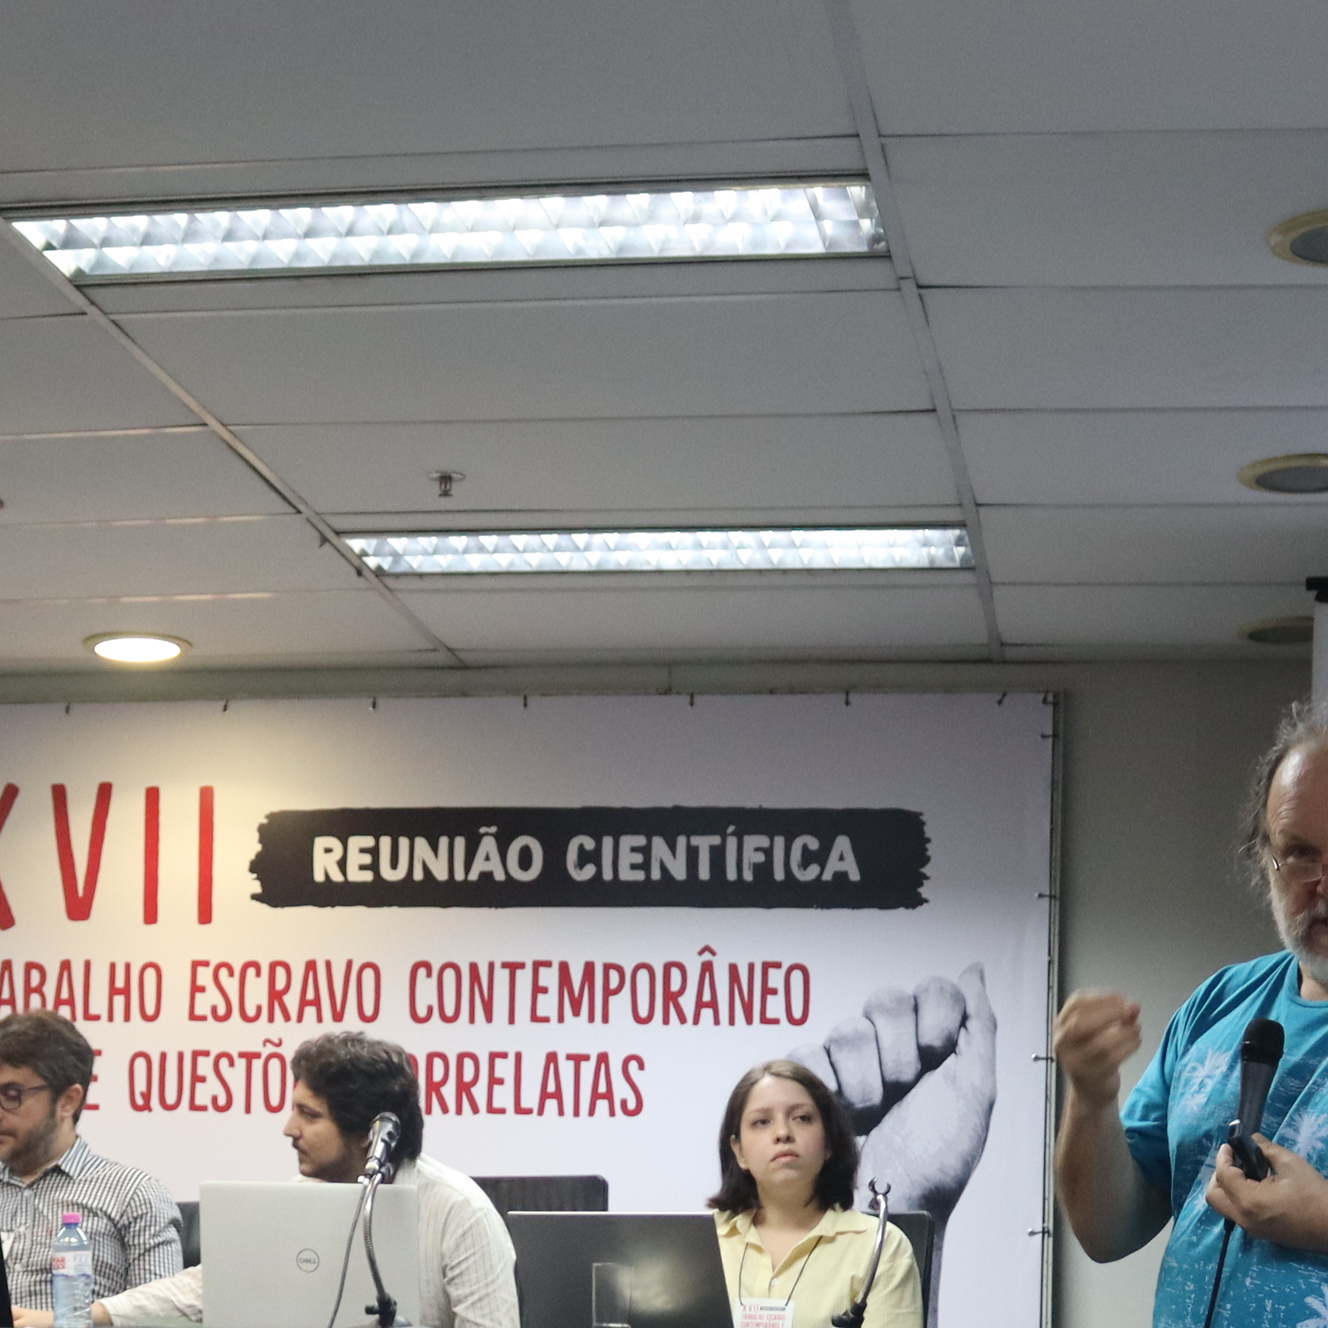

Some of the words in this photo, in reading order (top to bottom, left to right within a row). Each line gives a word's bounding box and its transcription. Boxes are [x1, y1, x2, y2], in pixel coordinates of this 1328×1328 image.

[311, 824, 544, 884] REUNIÃO
[565, 824, 862, 883] CIENTÍFICA
[188, 958, 383, 1024] ESCRAVO
[408, 945, 811, 1026] CONTEMPORÂNEO
[128, 1036, 297, 1115] QUESTÕ
[408, 1050, 646, 1118] RRELATAS
